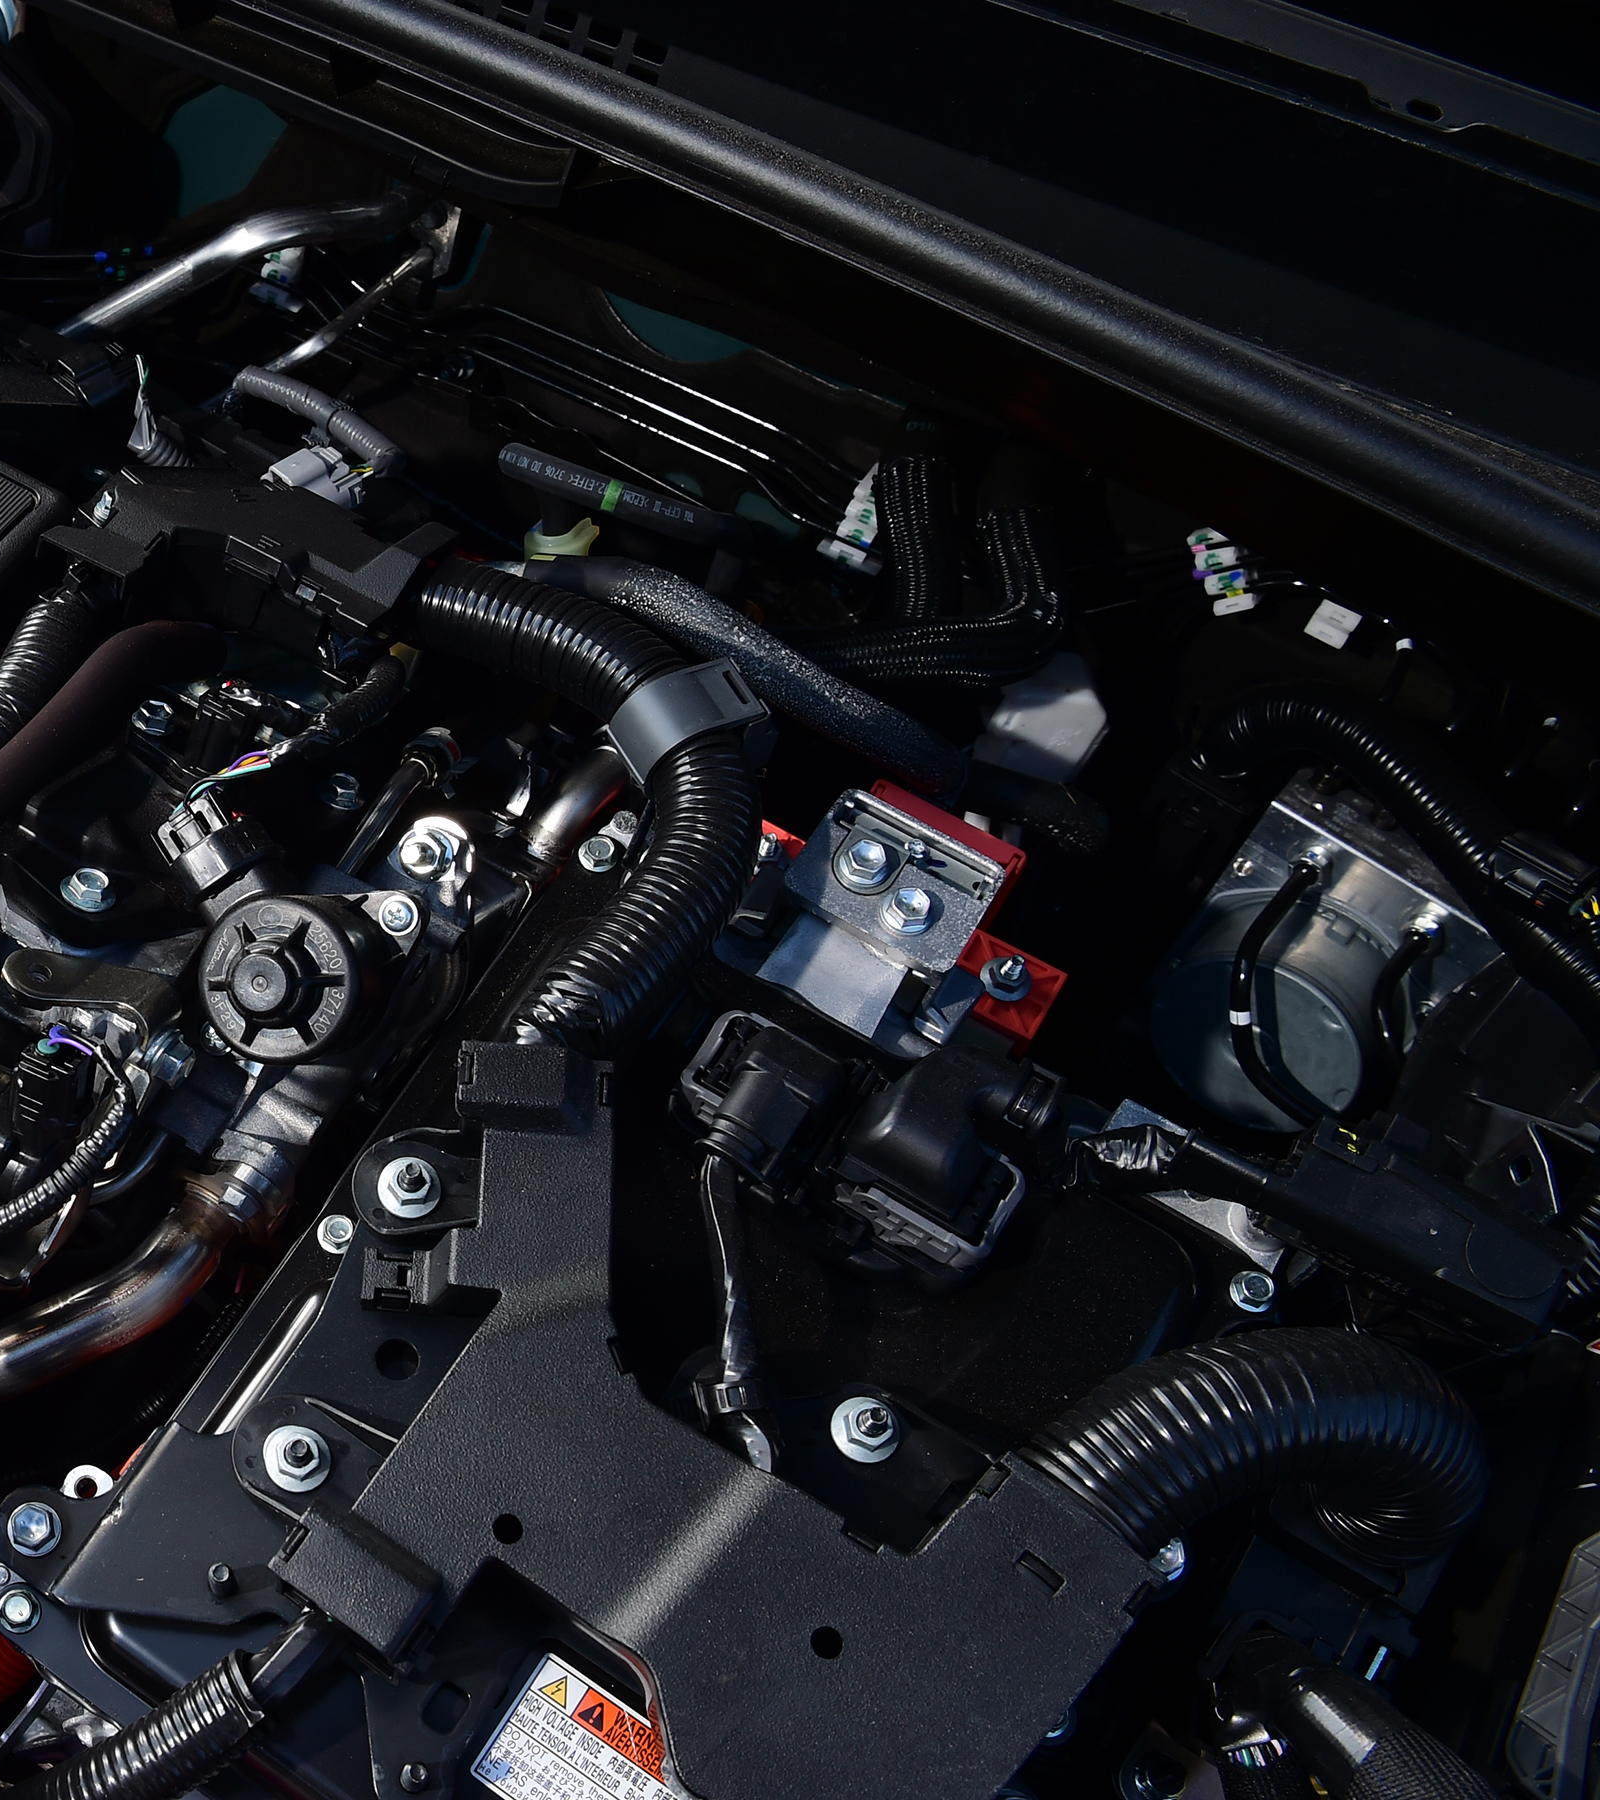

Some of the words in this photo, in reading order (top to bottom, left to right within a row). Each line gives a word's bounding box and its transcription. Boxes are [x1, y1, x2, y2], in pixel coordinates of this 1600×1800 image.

[310, 924, 343, 969] 25620
[211, 994, 236, 1030] 3F29
[314, 989, 345, 1034] 37140
[521, 1692, 544, 1717] HIGH
[543, 1706, 579, 1741] VOLTAGE
[576, 1732, 605, 1760] INSIDE
[614, 1711, 657, 1753] WARN
[479, 1764, 492, 1776] не
[485, 1751, 503, 1770] NE
[505, 1766, 528, 1787] PAS
[503, 1724, 521, 1741] DO
[524, 1739, 548, 1760] NOT
[550, 1759, 585, 1788] remove
[512, 1709, 539, 1734] HAUTE
[538, 1726, 572, 1757] TENSION
[568, 1747, 577, 1762] À
[575, 1752, 621, 1793] L'INTÉRIEUR
[607, 1755, 651, 1792] 内部高電圧
